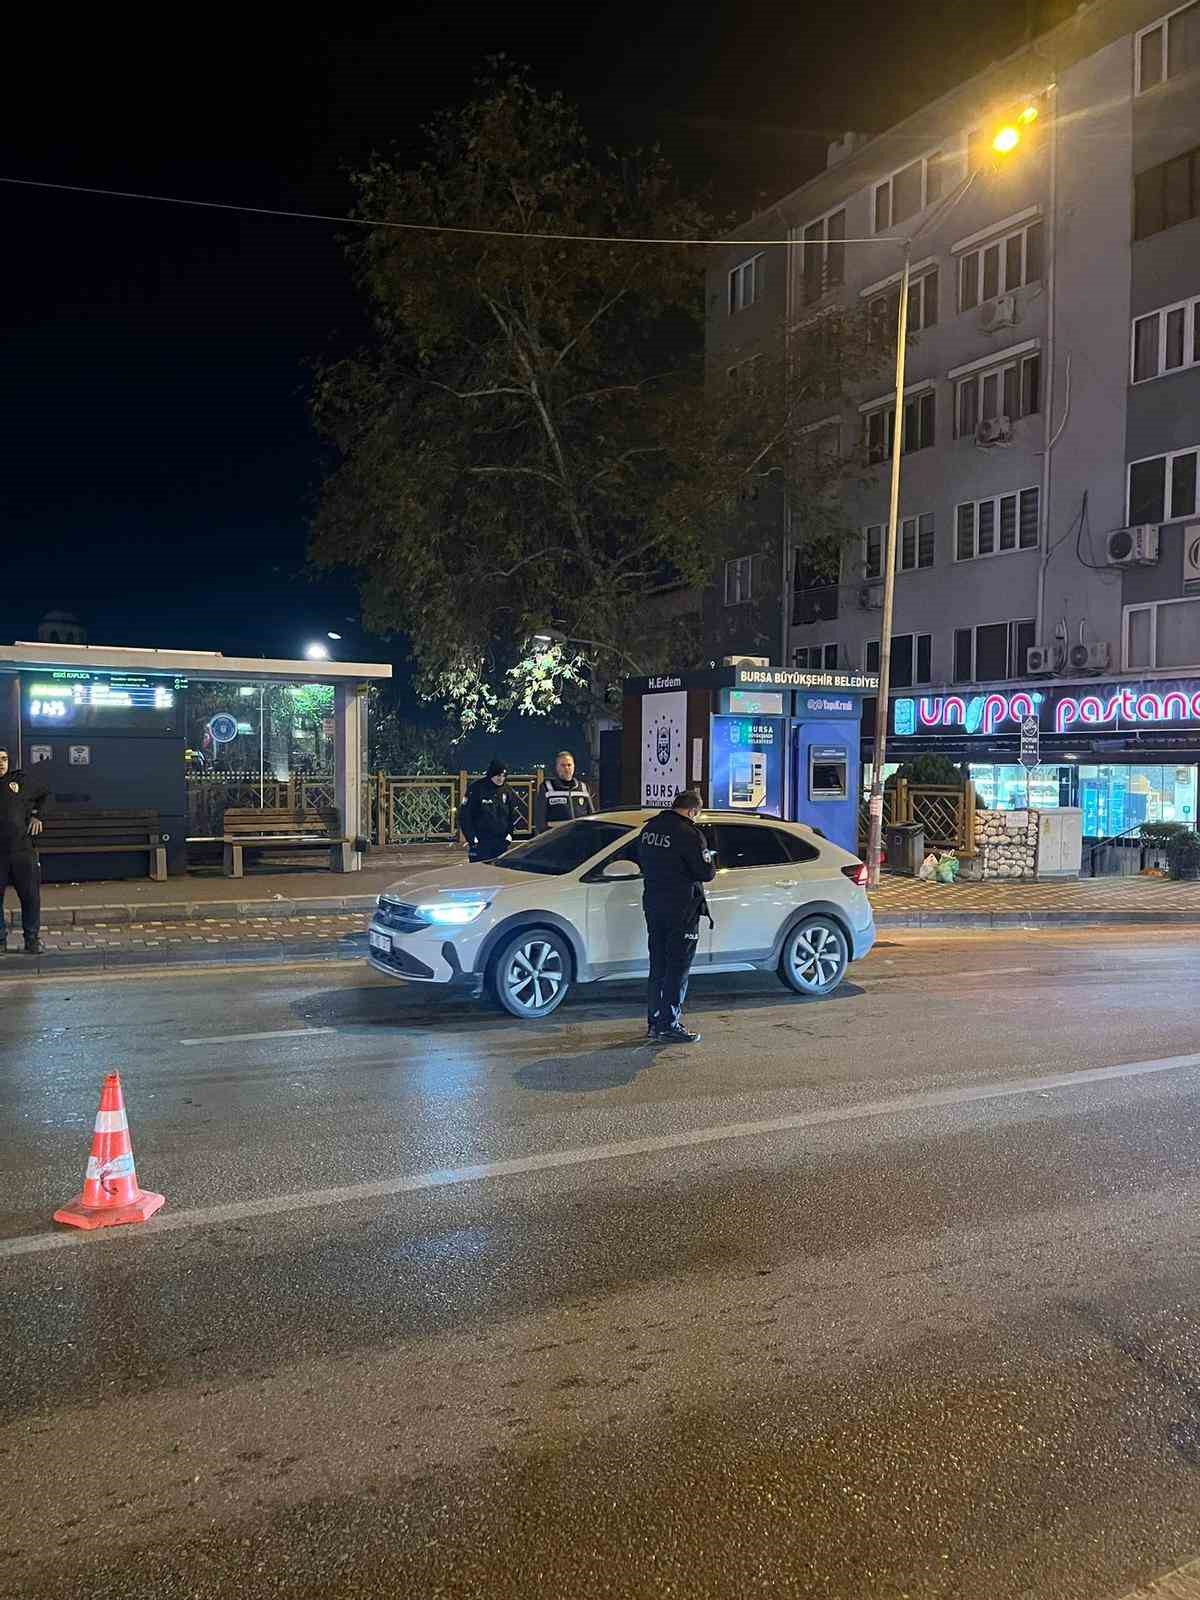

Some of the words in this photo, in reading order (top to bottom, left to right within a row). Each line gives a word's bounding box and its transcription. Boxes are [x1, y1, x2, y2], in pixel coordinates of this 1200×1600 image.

[648, 677, 681, 689] H.Erdem
[740, 671, 773, 683] BURSA
[774, 671, 833, 689] BÜYÜKŞEHİR
[646, 784, 681, 798] BURSA
[641, 832, 671, 848] POLİS
